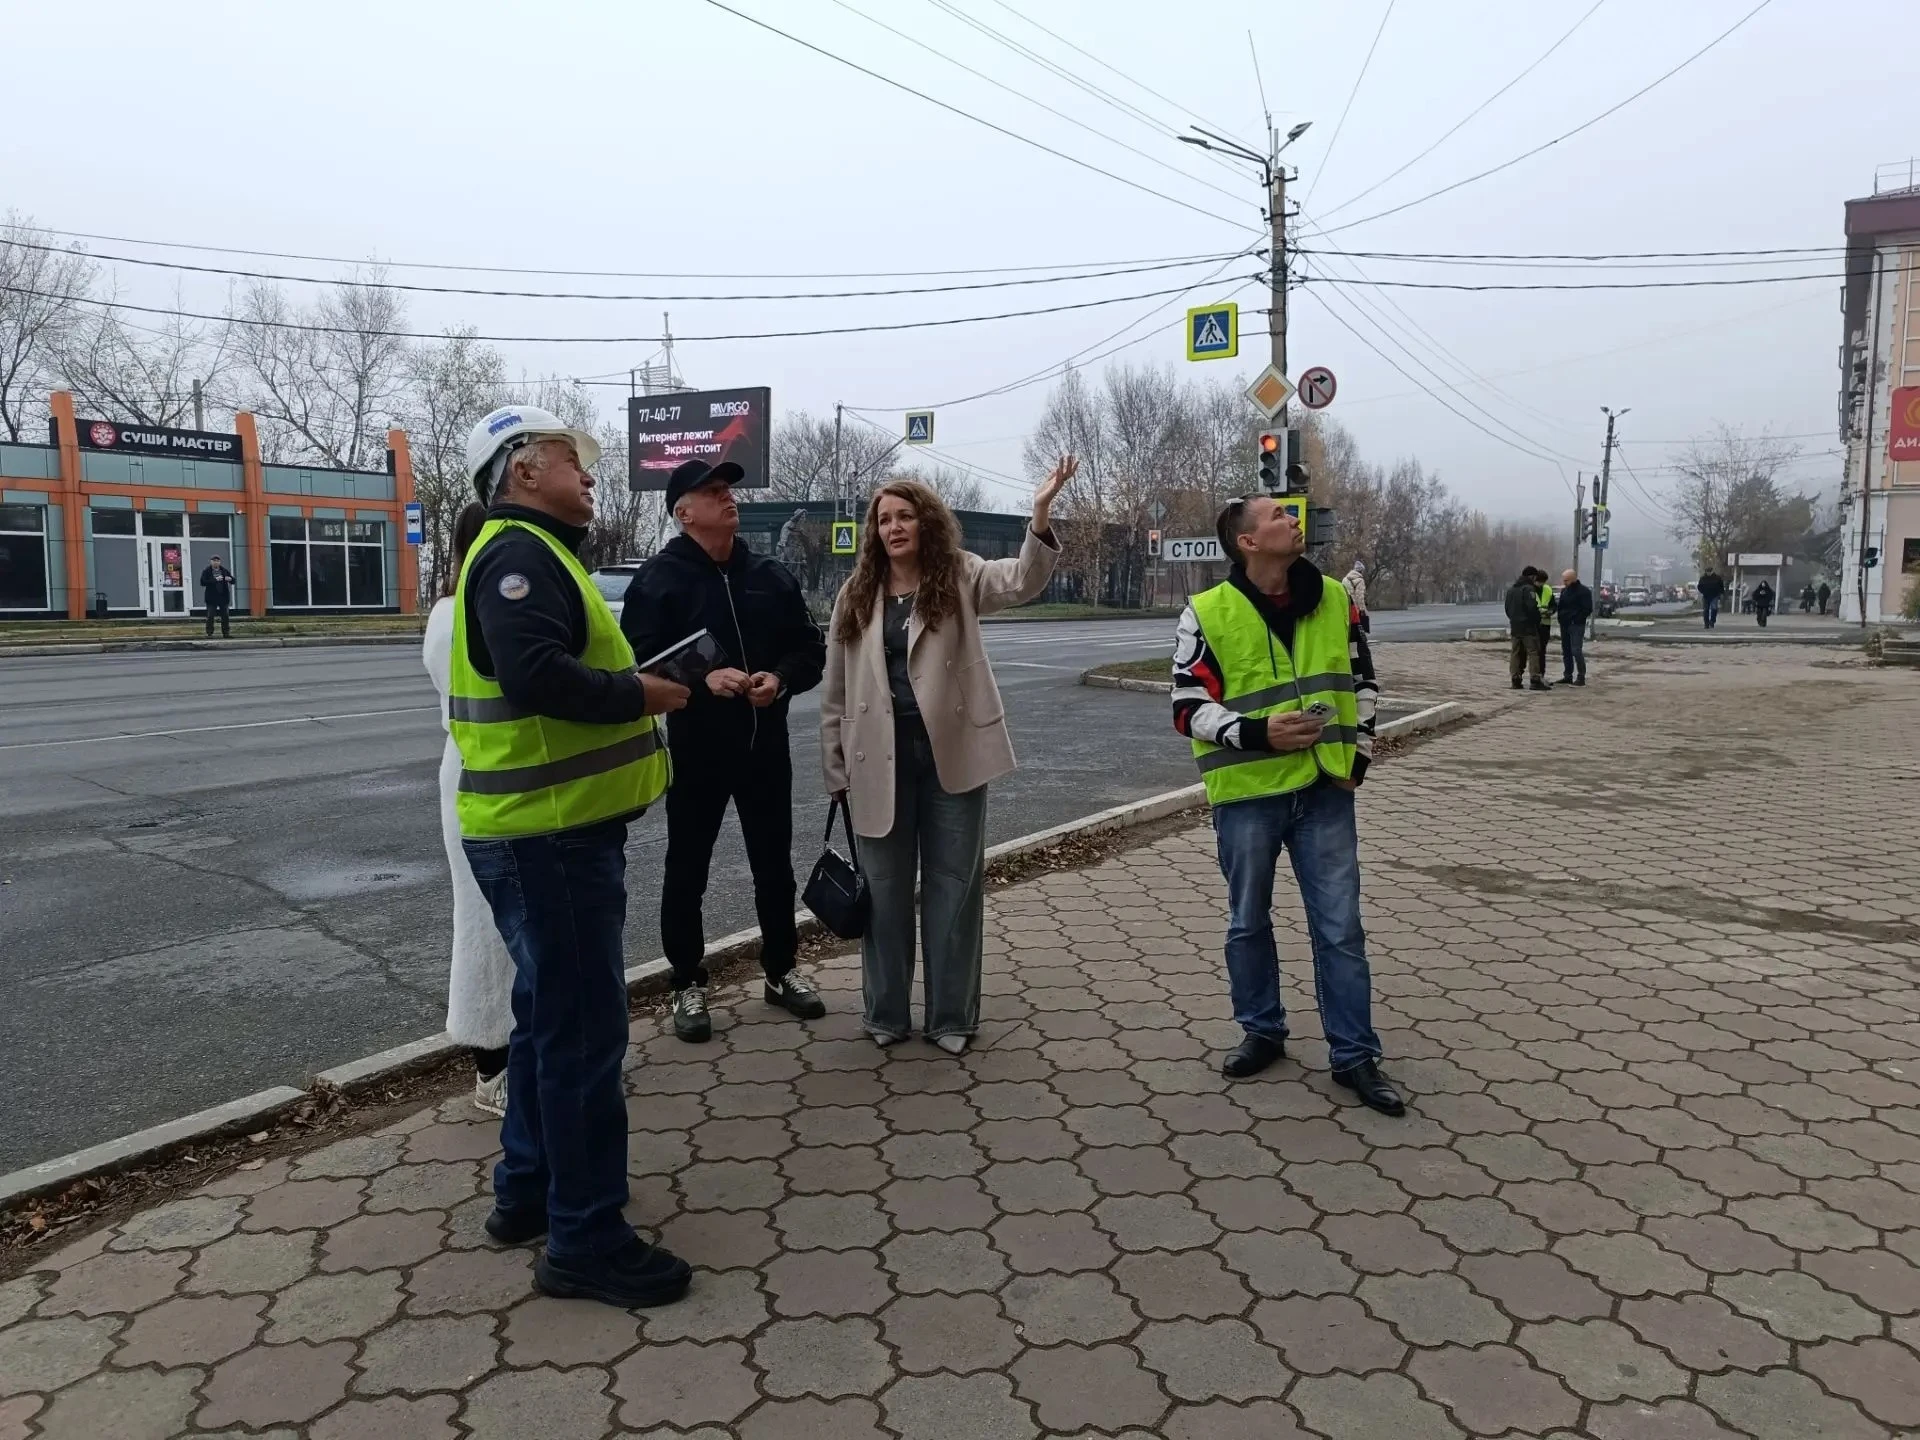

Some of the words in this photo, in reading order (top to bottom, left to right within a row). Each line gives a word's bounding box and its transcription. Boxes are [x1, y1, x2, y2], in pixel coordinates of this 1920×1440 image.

[639, 406, 681, 422] 77-40-77
[121, 431, 167, 446] СУШИ
[172, 435, 232, 452] МАСТЕР
[639, 432, 682, 444] Интернет
[684, 430, 714, 440] лежит
[1894, 437, 1920, 448] ДИ
[664, 445, 693, 456] Экран
[694, 443, 722, 454] стоит
[1172, 541, 1217, 557] СТОП
